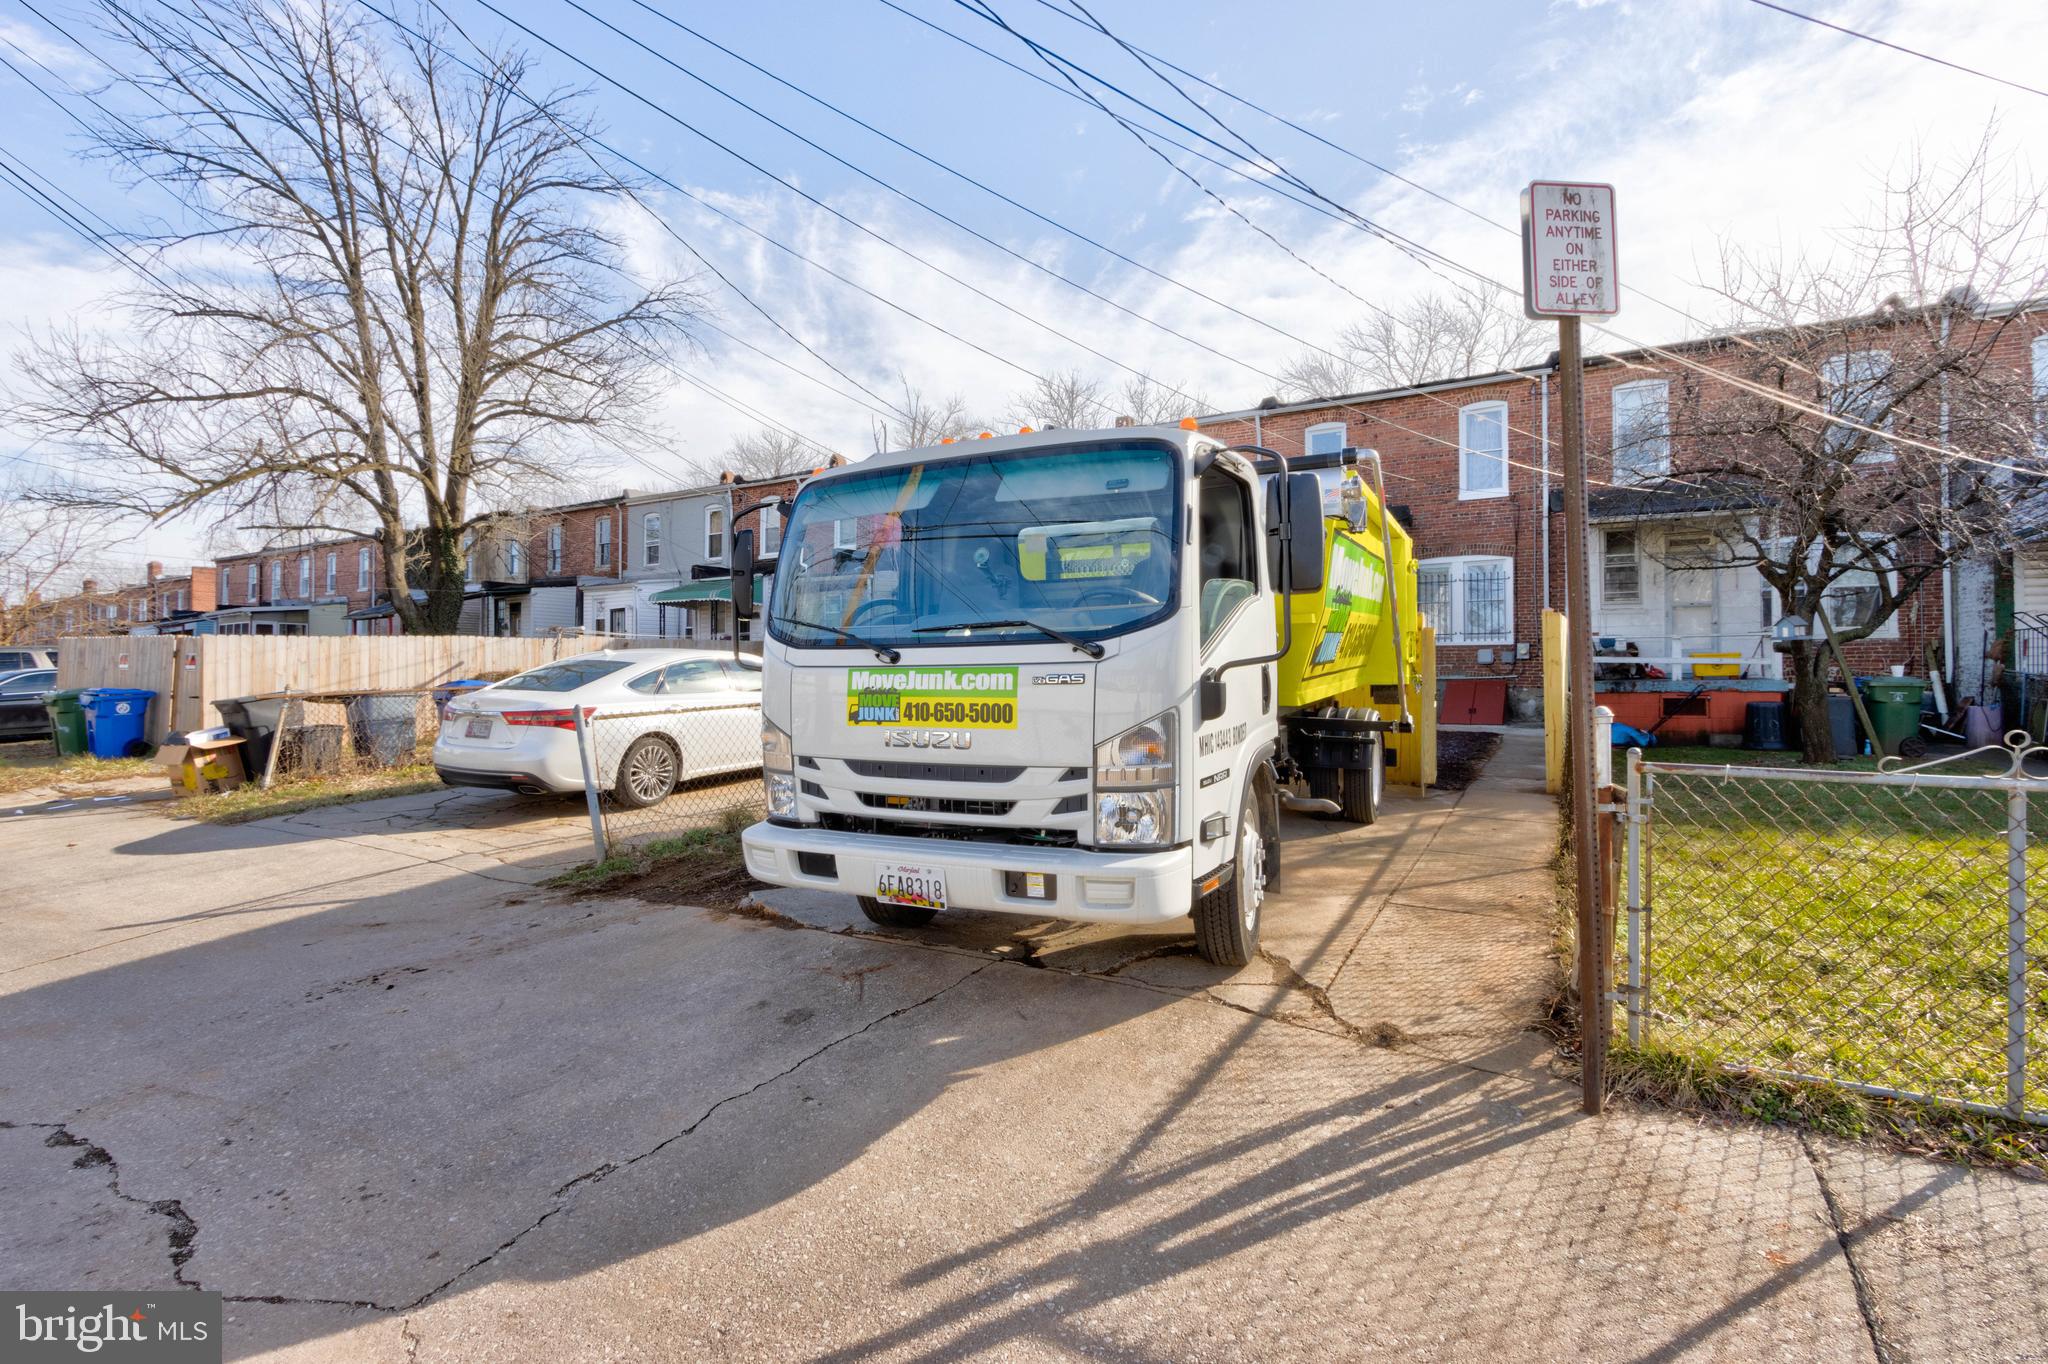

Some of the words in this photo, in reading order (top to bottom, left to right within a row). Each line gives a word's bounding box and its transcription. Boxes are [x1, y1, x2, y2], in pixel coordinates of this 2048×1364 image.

[1563, 192, 1582, 206] NO
[1545, 208, 1601, 223] PARKING
[1545, 225, 1602, 240] ANYTIME
[1565, 242, 1583, 255] ON
[1553, 259, 1598, 273] EITHER
[1549, 275, 1578, 289] SIDE
[1586, 276, 1604, 289] OF
[1555, 292, 1598, 306] ALLEY
[851, 670, 1014, 690] MoveJunk.com
[858, 707, 896, 721] JUNK
[884, 729, 972, 750] ISUZU
[879, 874, 942, 899] 6FA8318
